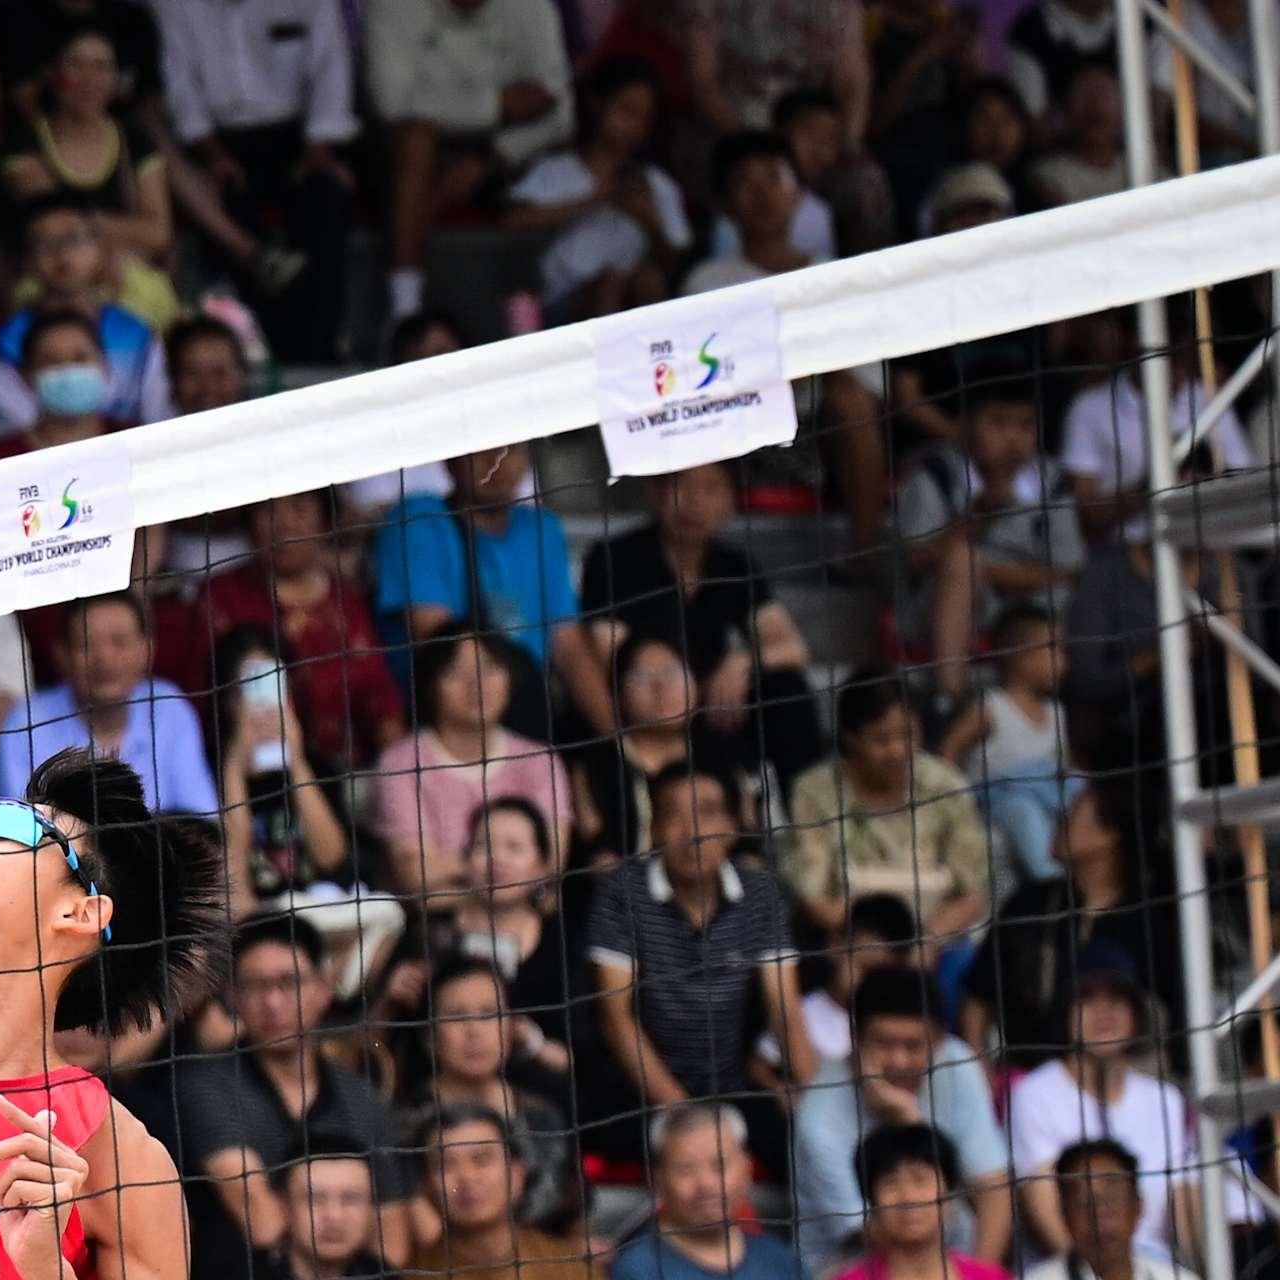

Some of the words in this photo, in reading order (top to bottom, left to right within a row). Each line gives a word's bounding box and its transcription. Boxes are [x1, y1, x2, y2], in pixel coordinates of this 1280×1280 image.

[19, 485, 40, 500] FIVB
[14, 548, 44, 567] WORLD
[45, 534, 113, 560] CHAMPIONSHIPS
